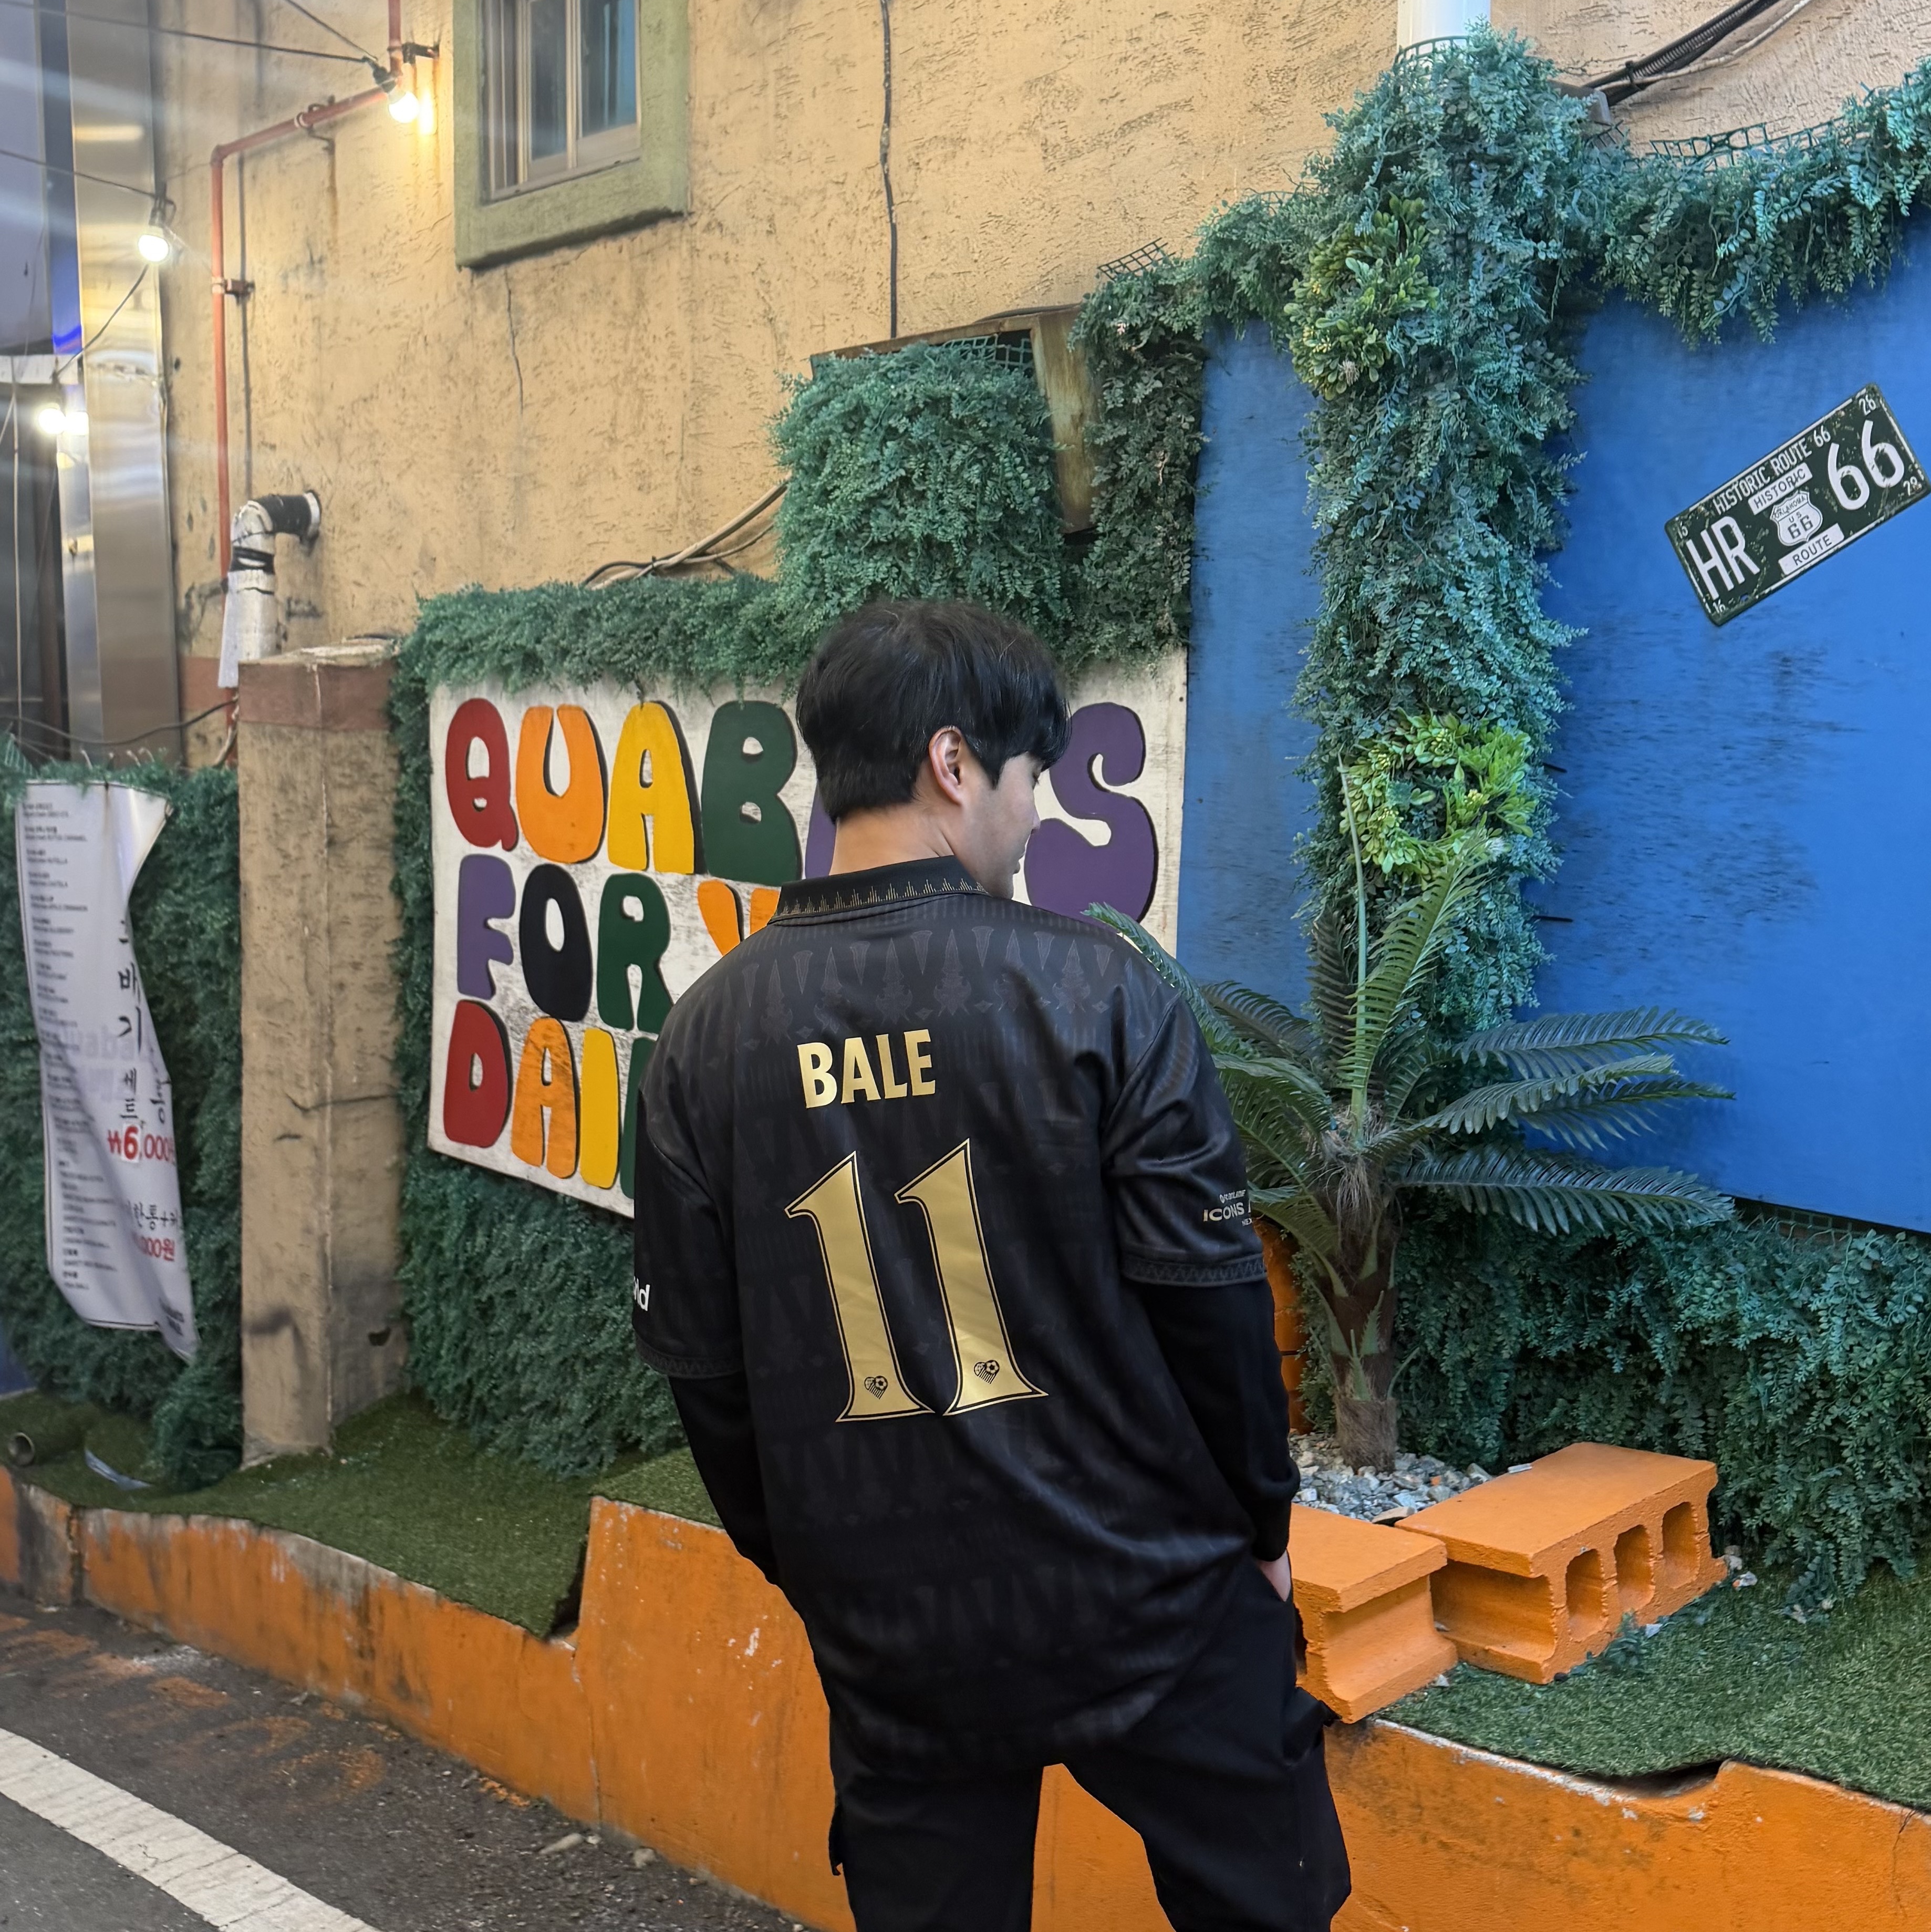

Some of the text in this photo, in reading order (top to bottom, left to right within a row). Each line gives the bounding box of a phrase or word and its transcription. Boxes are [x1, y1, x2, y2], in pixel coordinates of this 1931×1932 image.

[1712, 466, 1770, 515] HISTORIC
[1770, 437, 1812, 476] ROUTE
[1753, 468, 1806, 510] HISTORIC
[1828, 420, 1905, 511] 66
[1686, 516, 1760, 601] HR
[1788, 515, 1813, 540] 66
[1792, 534, 1832, 566] ROUTE
[458, 854, 676, 1033] FOR
[797, 1028, 936, 1109] BALE
[1203, 1202, 1245, 1222] ICONS
[784, 1138, 1049, 1422] 11
